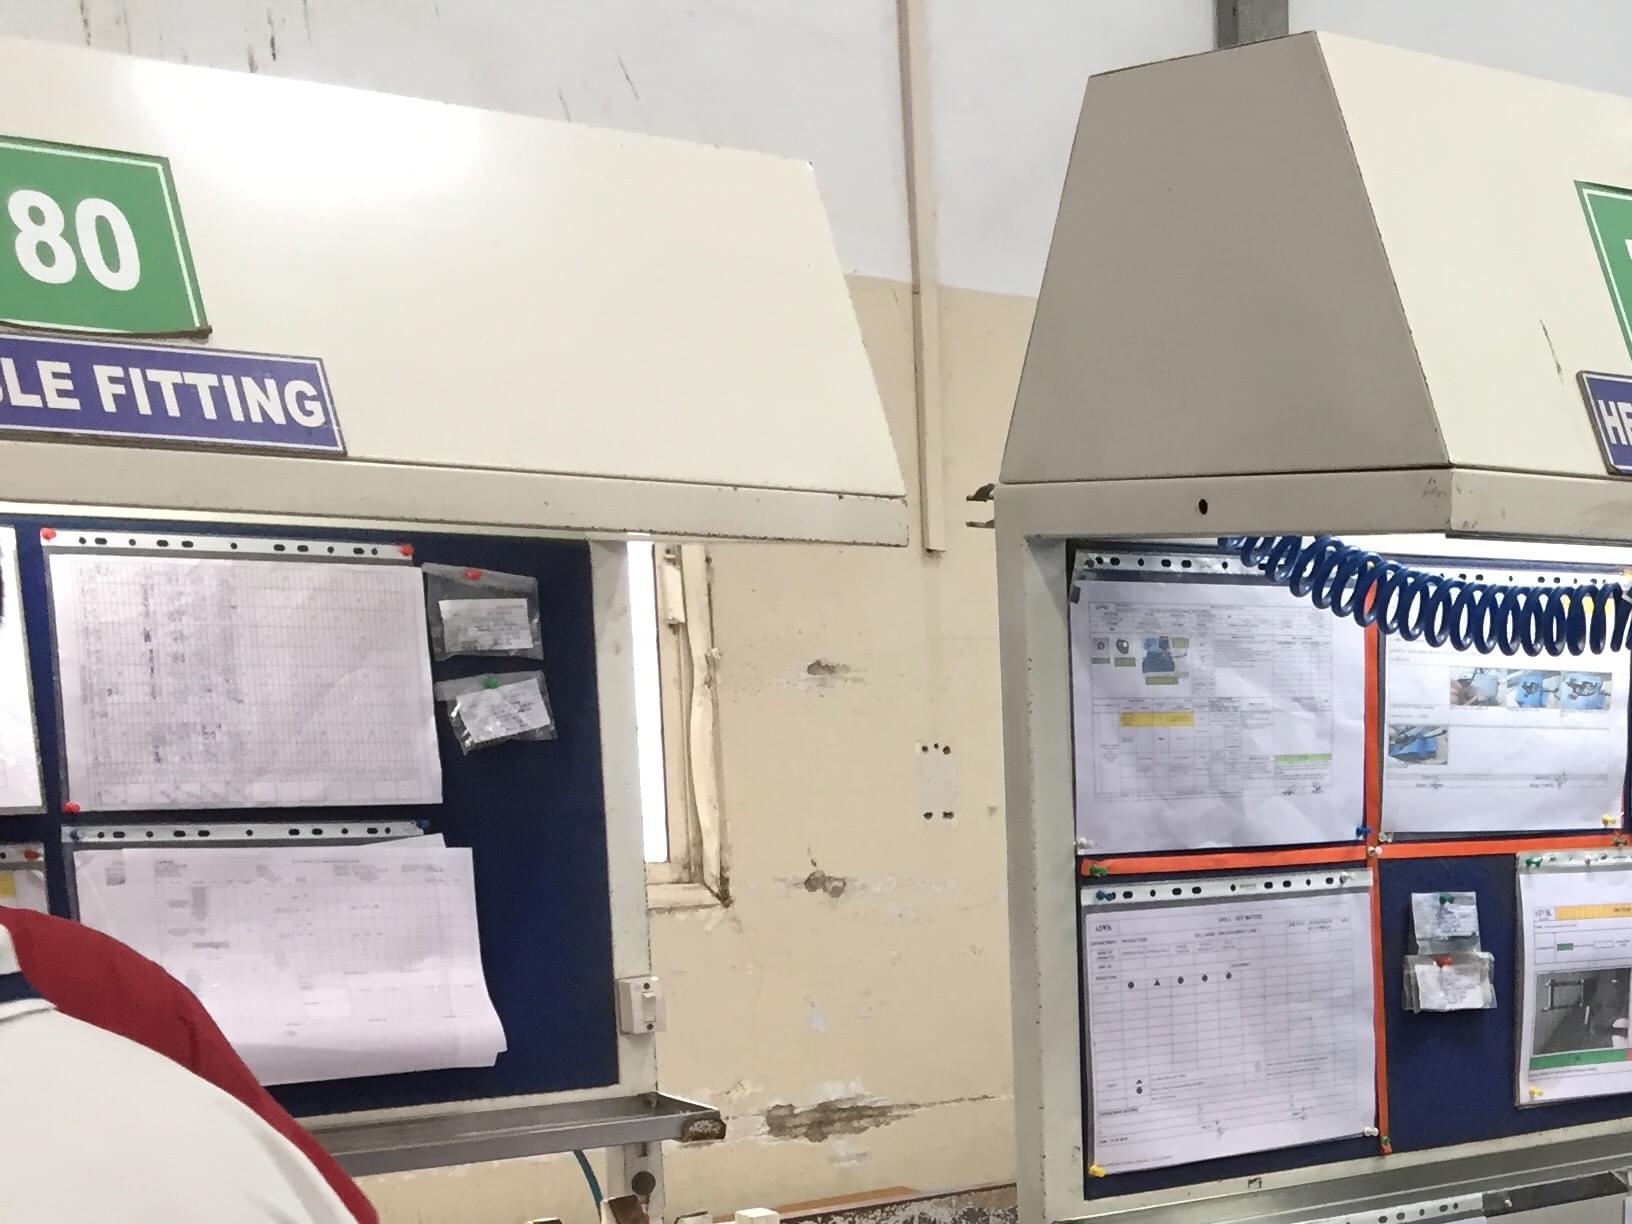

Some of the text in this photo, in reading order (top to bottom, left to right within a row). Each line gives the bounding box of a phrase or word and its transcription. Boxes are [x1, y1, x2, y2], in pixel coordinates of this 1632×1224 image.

[8, 189, 140, 291] 80
[0, 357, 326, 428] LE FITTING
